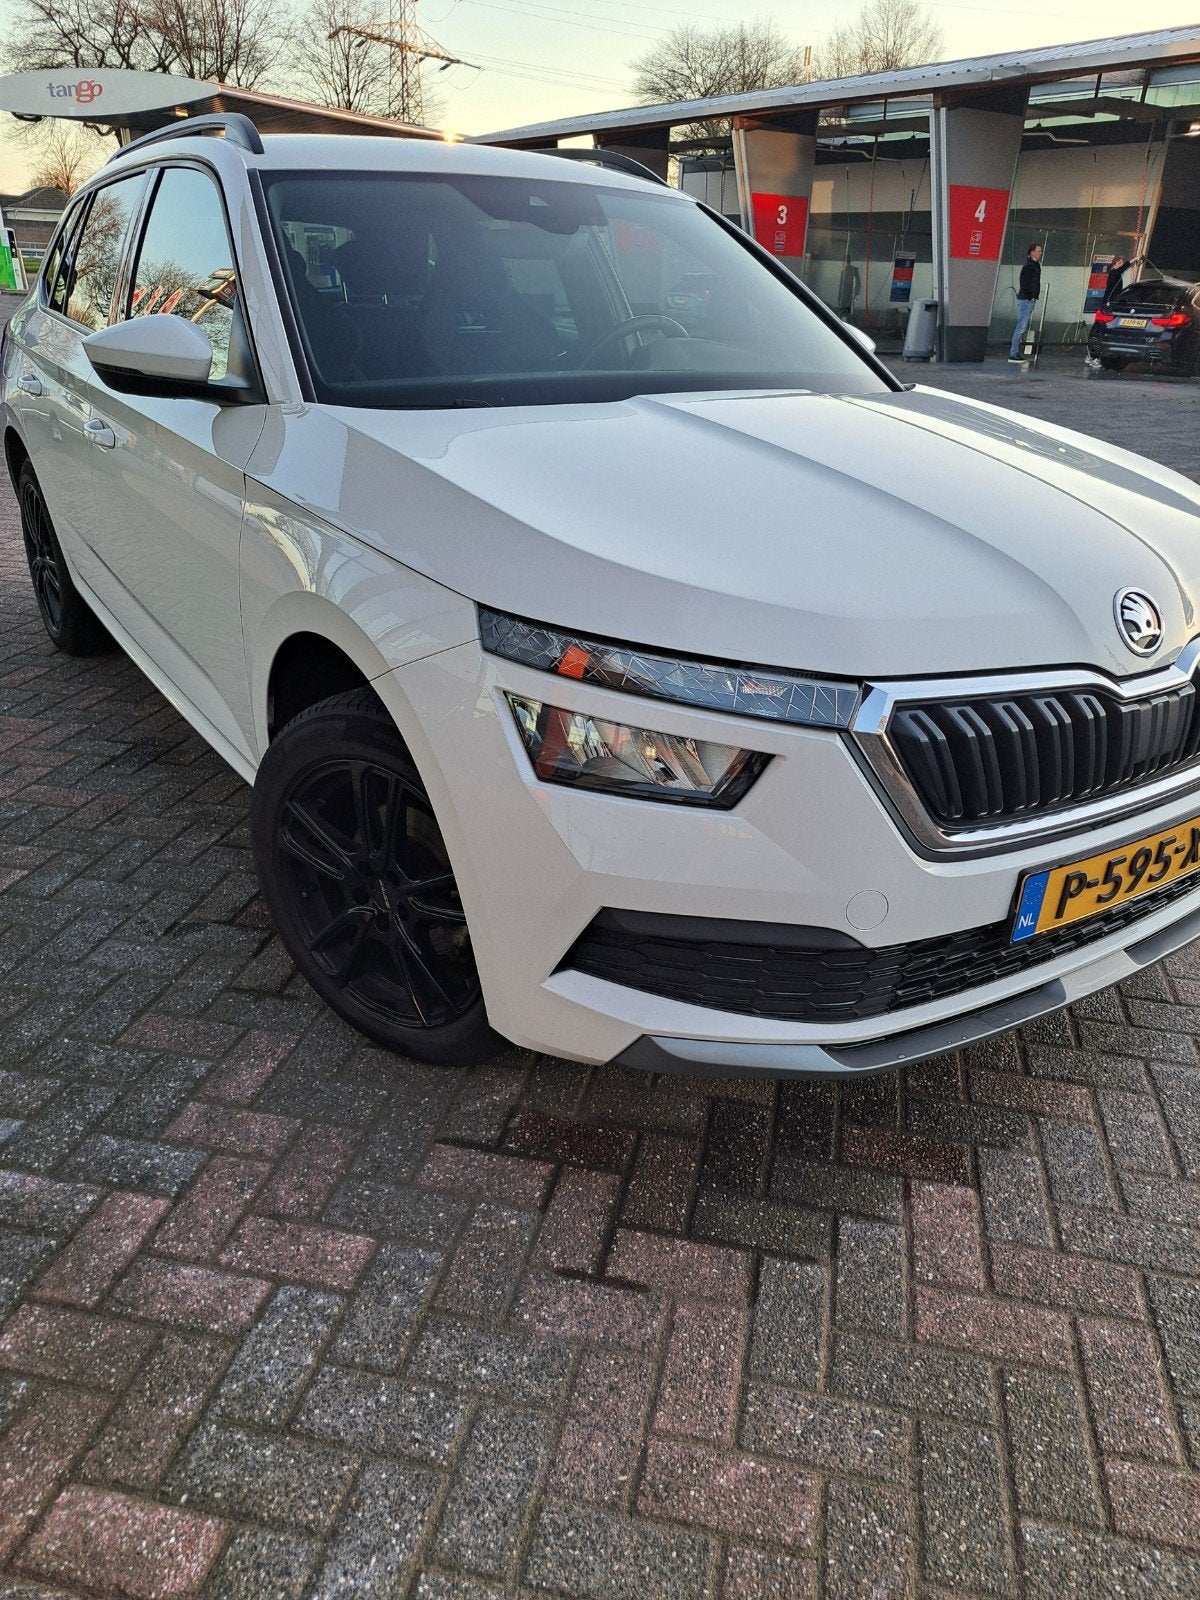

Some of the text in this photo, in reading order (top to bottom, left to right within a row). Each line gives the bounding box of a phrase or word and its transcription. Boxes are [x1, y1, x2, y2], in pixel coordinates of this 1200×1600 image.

[46, 79, 104, 103] tango
[776, 204, 788, 225] 3
[974, 200, 987, 223] 4
[1018, 912, 1035, 930] NL
